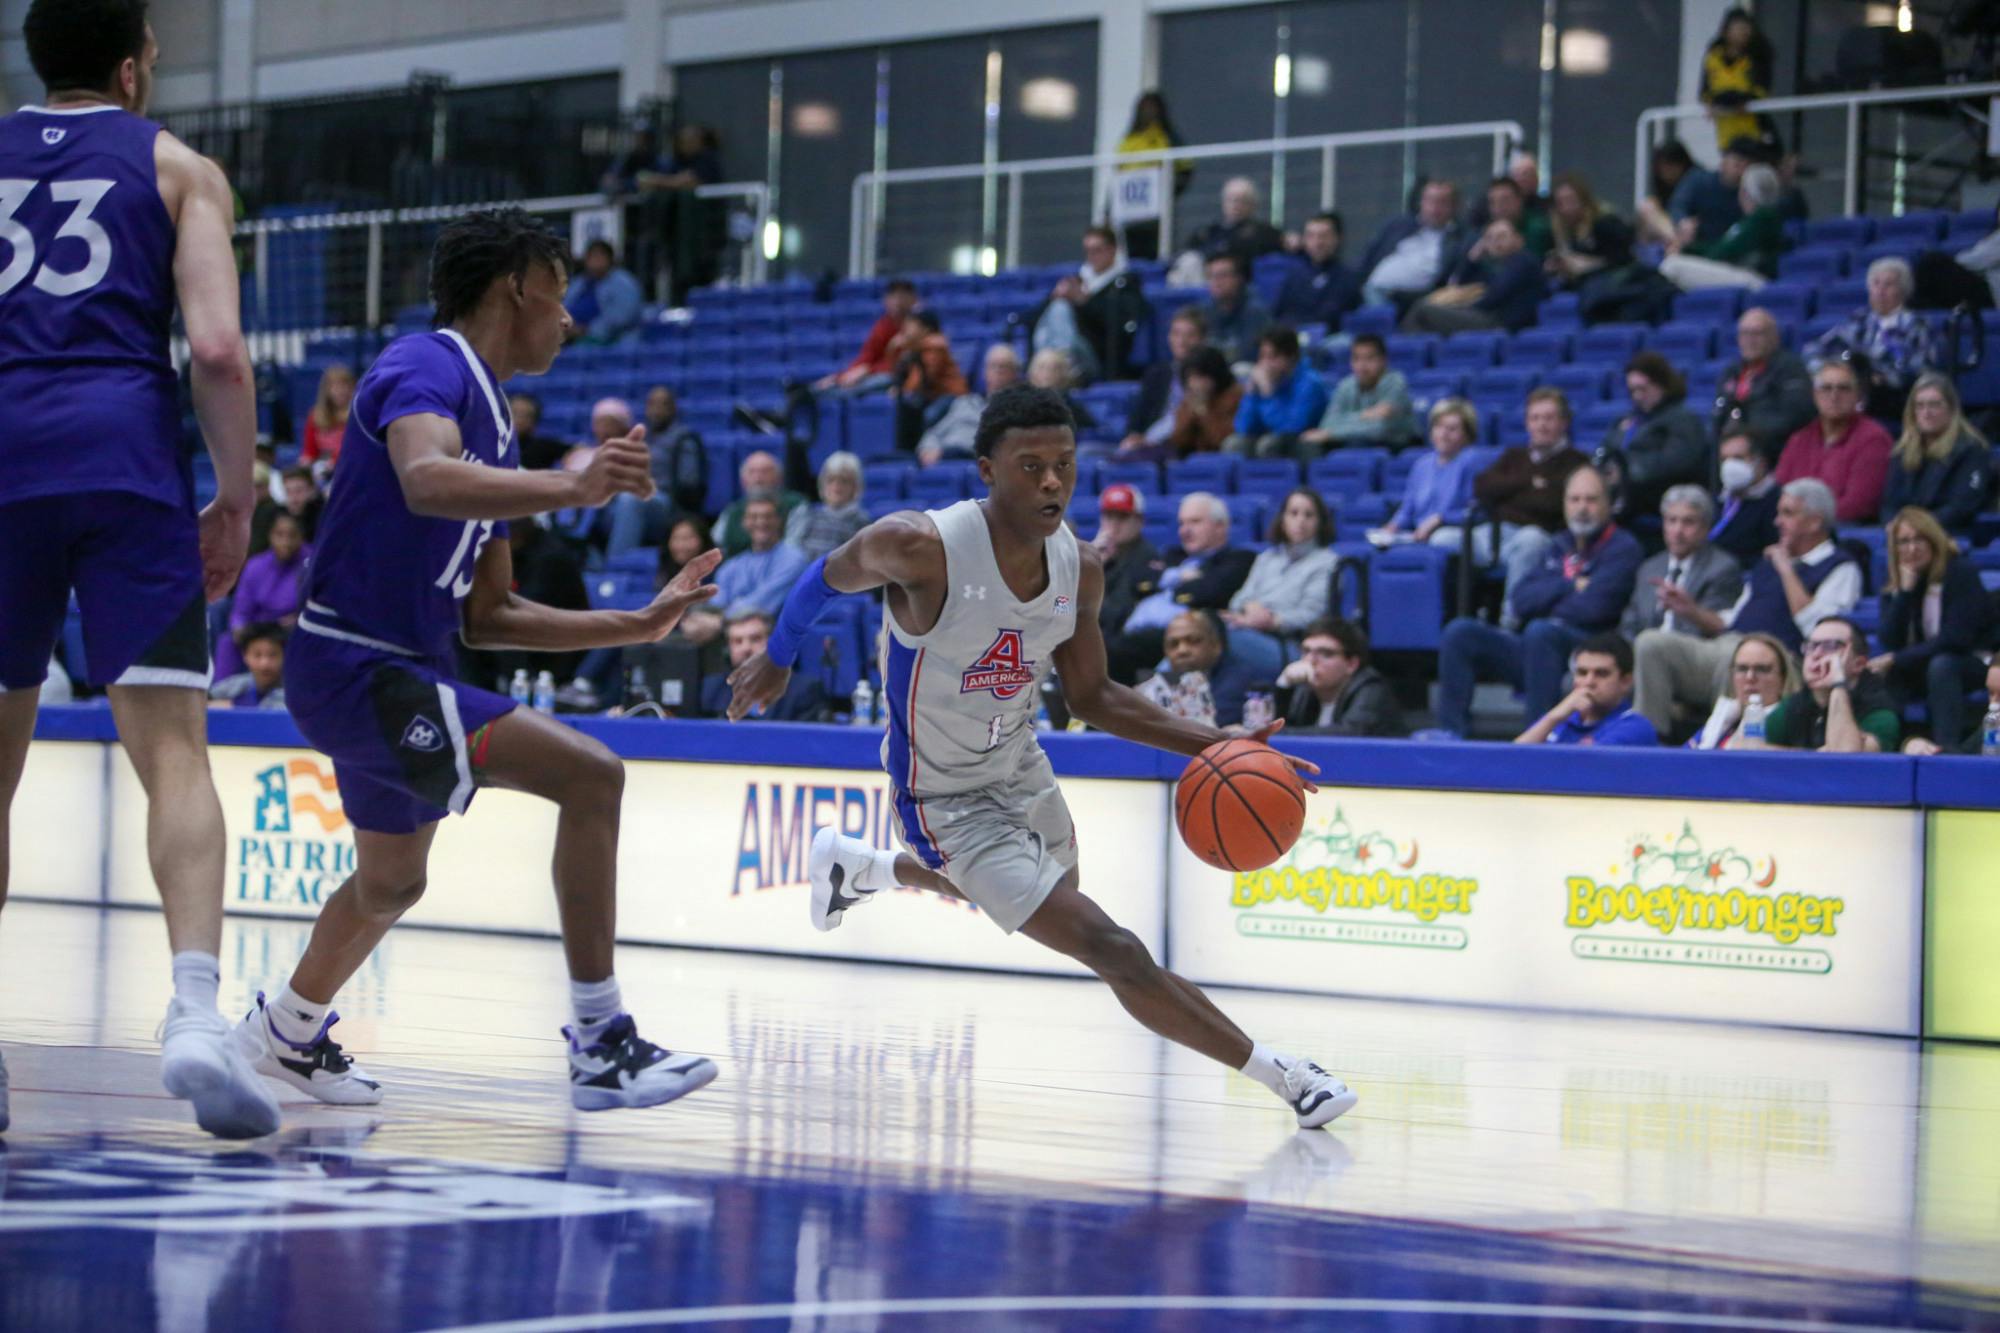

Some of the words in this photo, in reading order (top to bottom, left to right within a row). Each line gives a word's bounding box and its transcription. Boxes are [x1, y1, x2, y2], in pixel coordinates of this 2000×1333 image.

[0, 178, 118, 297] 33
[239, 838, 357, 873] PATRI
[1565, 875, 1843, 944] Booeymonger
